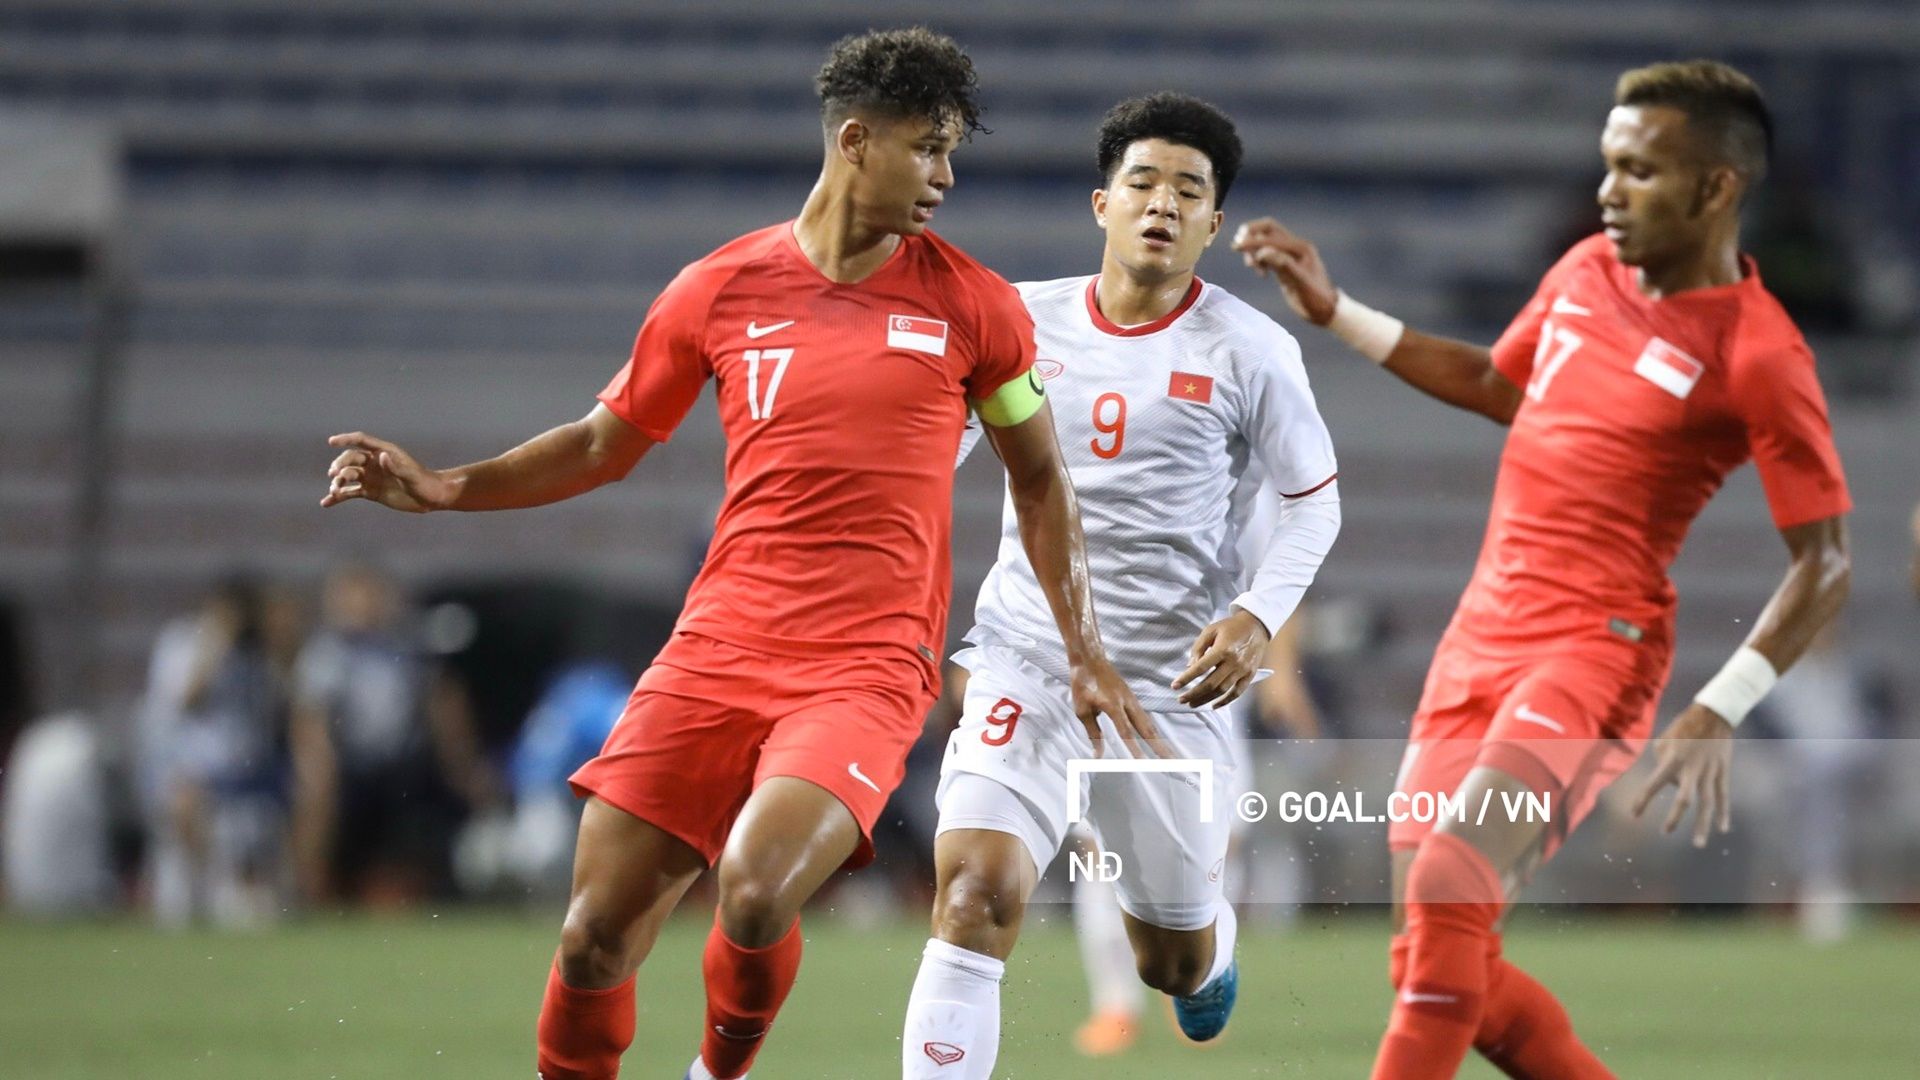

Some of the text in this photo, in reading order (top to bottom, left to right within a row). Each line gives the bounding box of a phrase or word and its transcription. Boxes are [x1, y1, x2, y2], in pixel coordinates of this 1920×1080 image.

[742, 348, 795, 420] 17
[1091, 392, 1126, 459] 9
[981, 698, 1022, 746] 9
